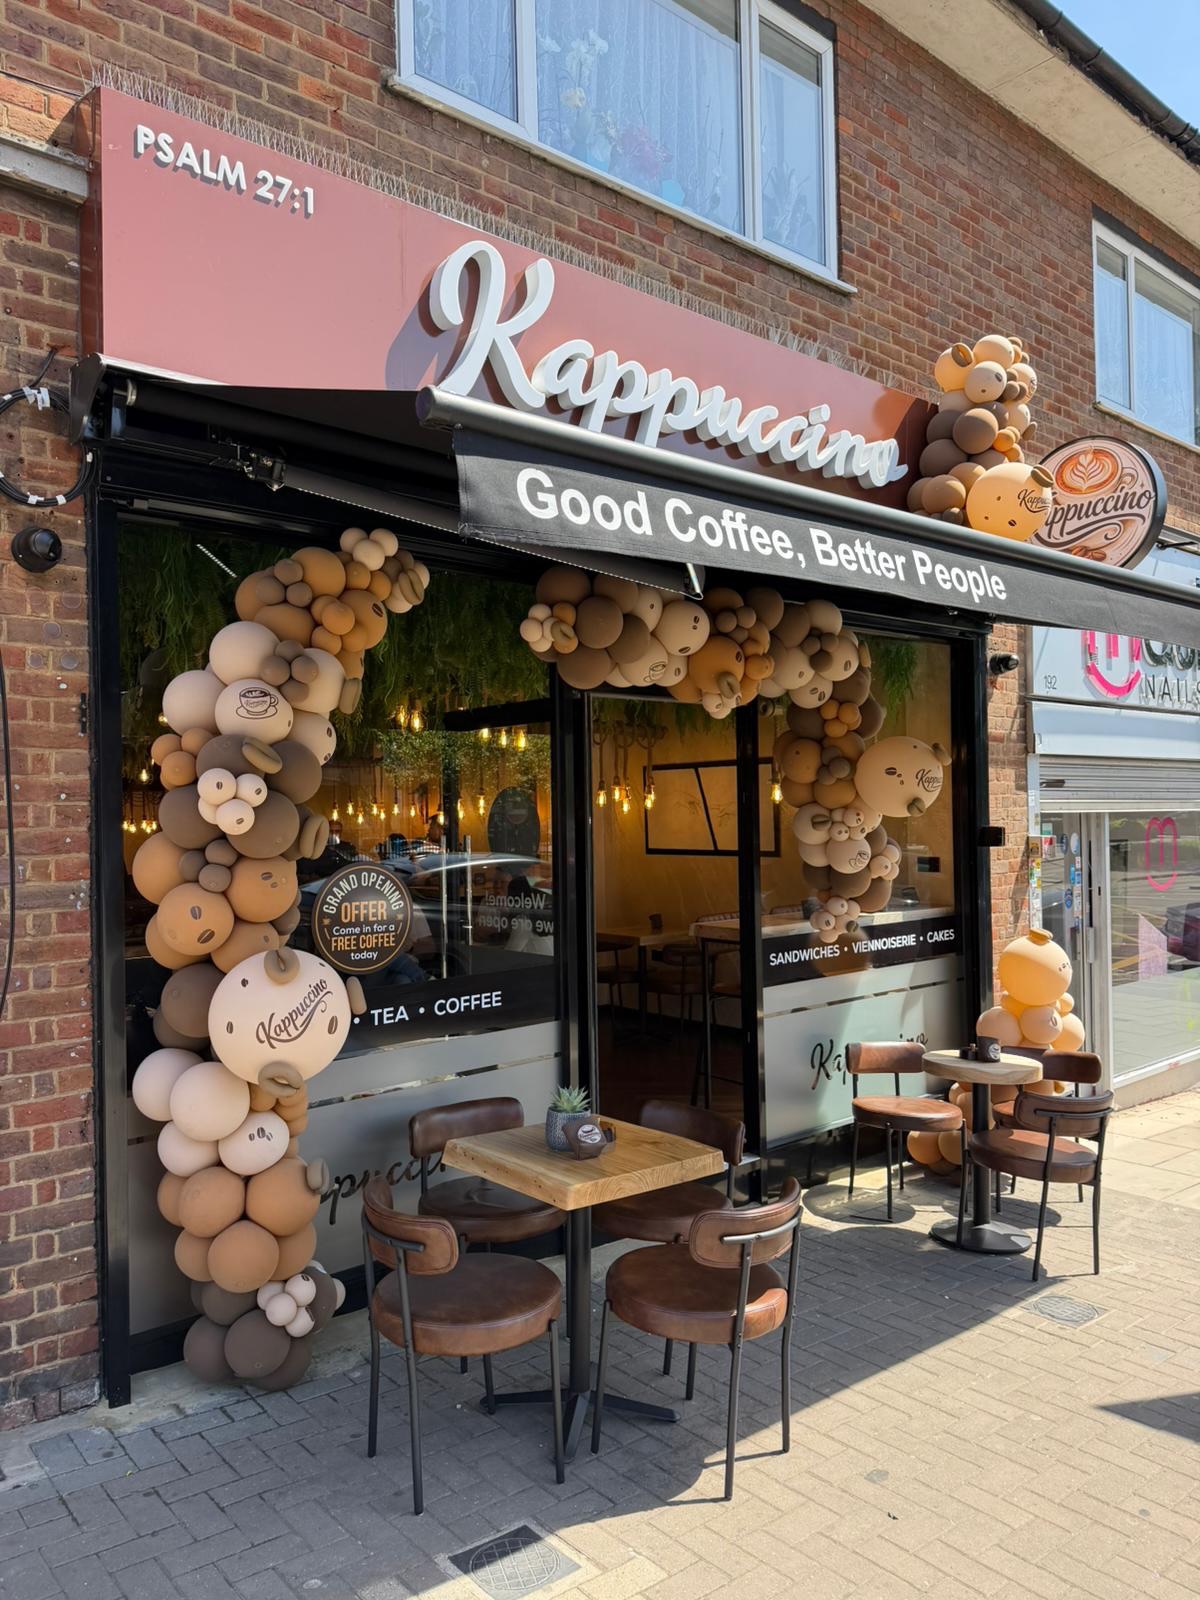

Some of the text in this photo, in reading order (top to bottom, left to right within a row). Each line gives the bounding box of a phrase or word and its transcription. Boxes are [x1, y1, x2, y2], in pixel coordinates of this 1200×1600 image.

[135, 124, 314, 215] PSALM 27:1
[429, 240, 909, 488] Kappuccino
[516, 468, 1007, 603] Good Coffee, Better People
[1044, 674, 1057, 690] 192
[1145, 674, 1200, 706] NAIL
[323, 872, 404, 914] GRAND OPENING
[341, 900, 387, 923] OFFER
[332, 933, 396, 951] FREE COFFEE
[333, 926, 360, 935] Come
[362, 924, 371, 933] in
[373, 924, 387, 932] for
[351, 951, 378, 960] today
[769, 929, 955, 966] SANDWICHES VIENNOISERIE CAKES
[256, 978, 329, 1049] Kappuccino
[370, 991, 502, 1025] TEA COFFEE
